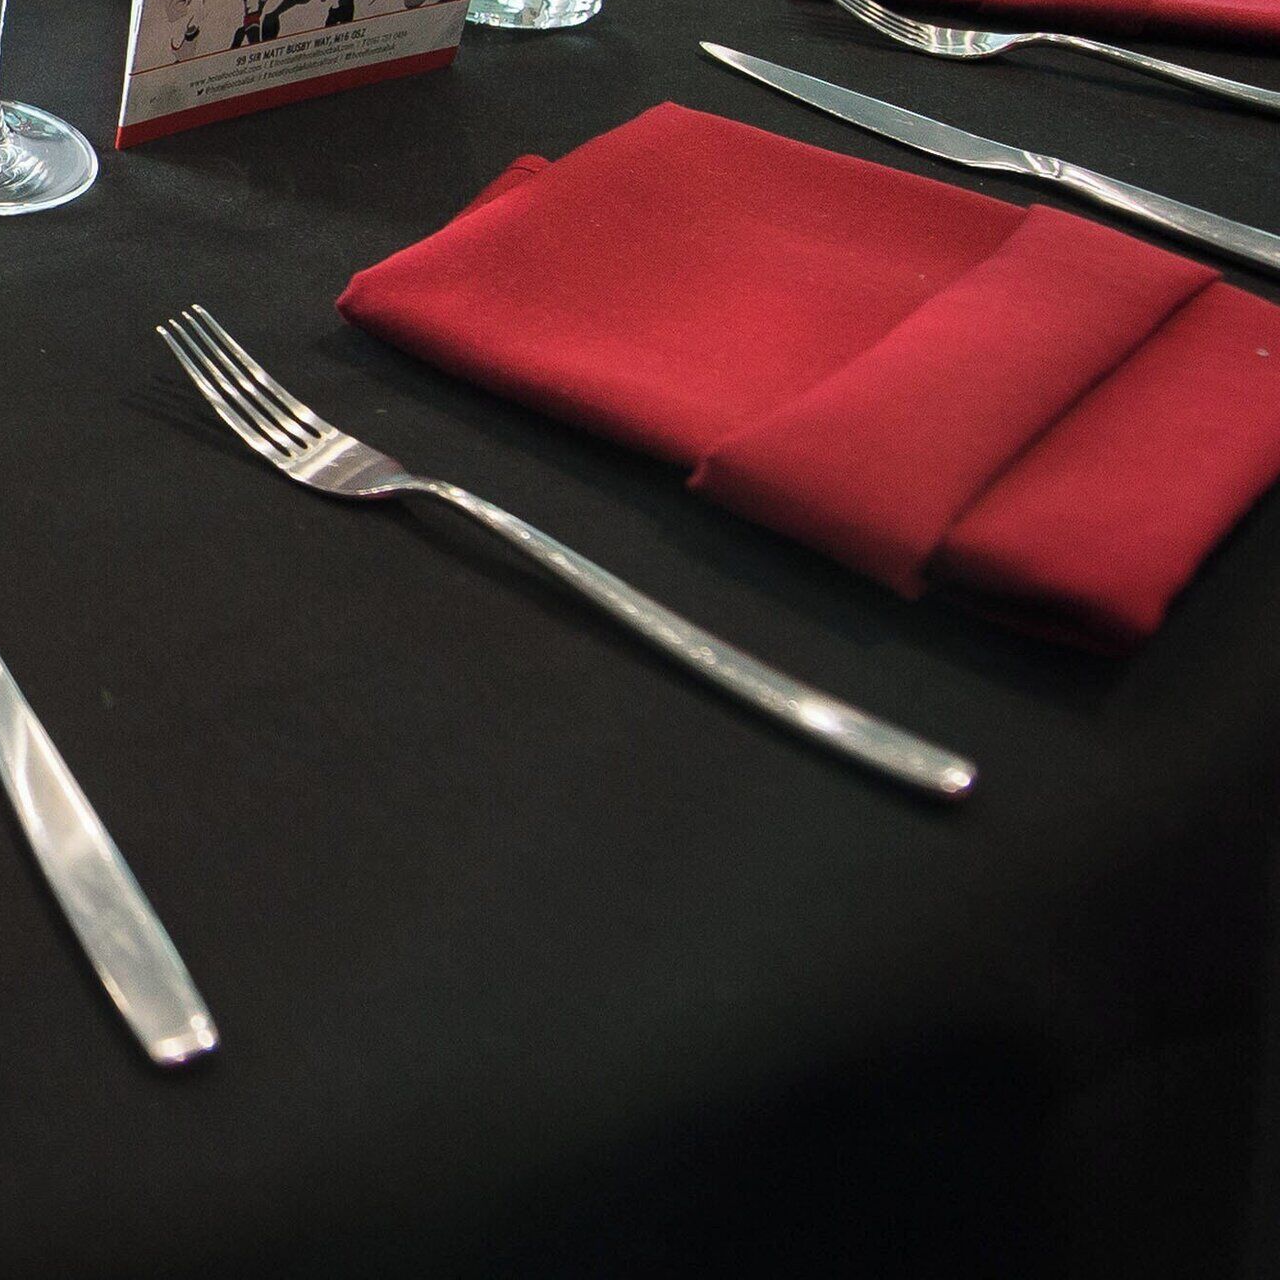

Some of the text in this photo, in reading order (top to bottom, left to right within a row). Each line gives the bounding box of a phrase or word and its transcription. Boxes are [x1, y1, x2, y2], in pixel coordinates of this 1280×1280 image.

[248, 51, 262, 63] SIR
[263, 46, 286, 61] MATT
[286, 41, 312, 55] BUSBY
[314, 36, 332, 48] WAY,
